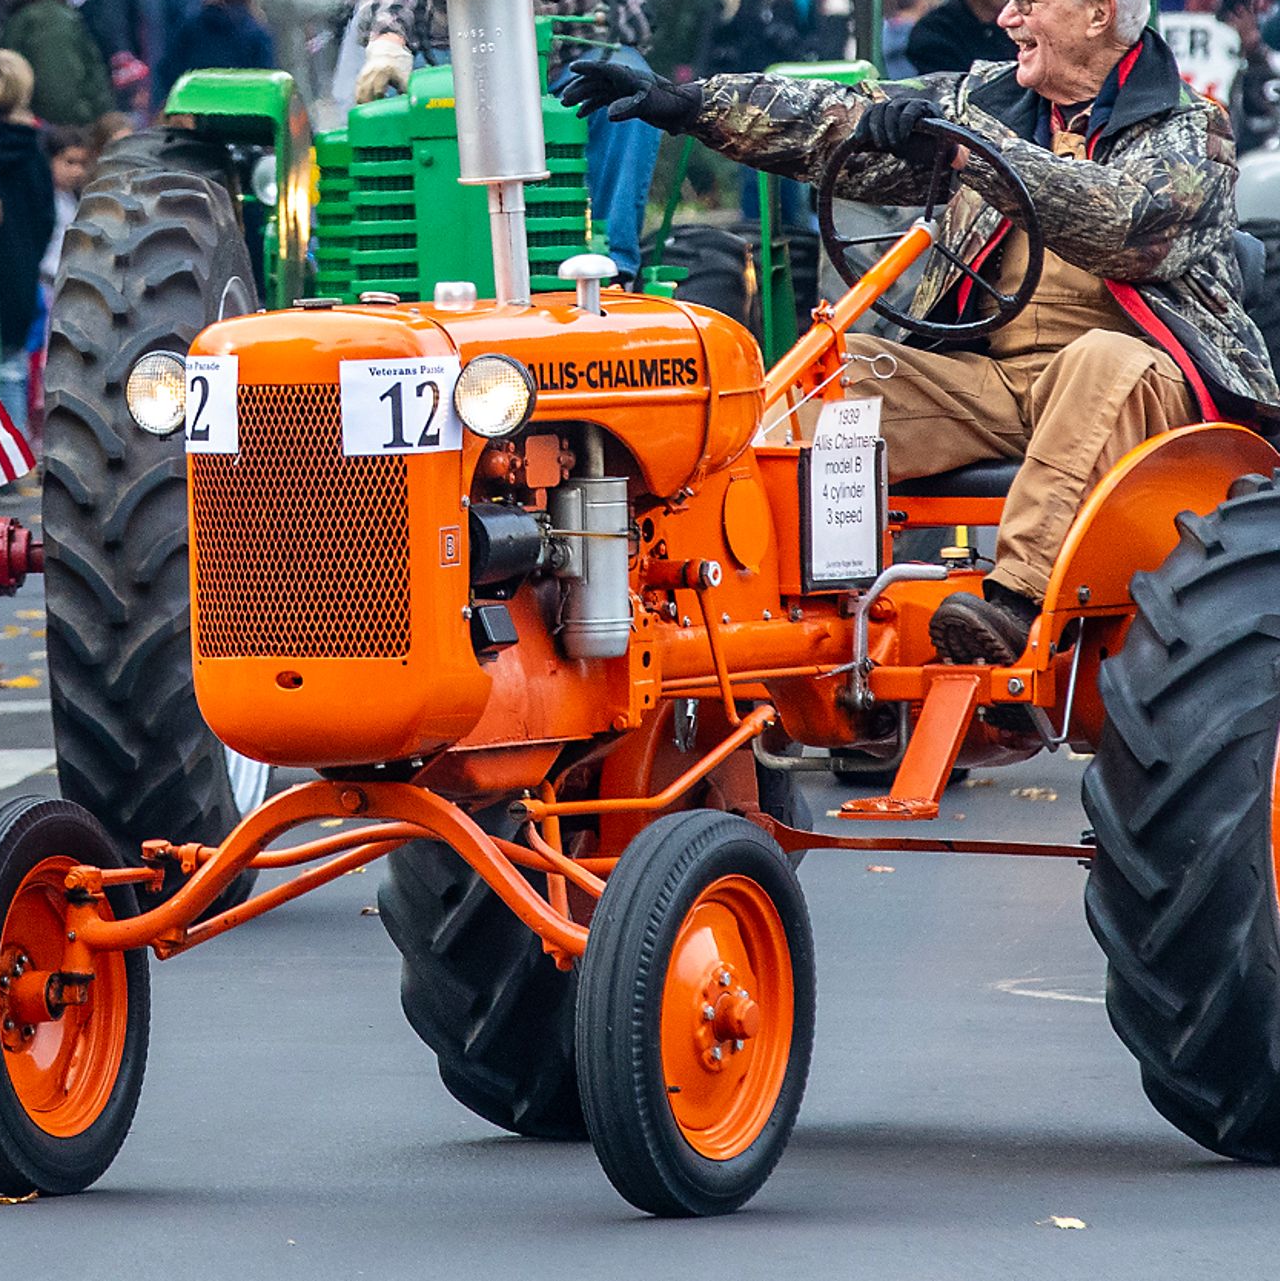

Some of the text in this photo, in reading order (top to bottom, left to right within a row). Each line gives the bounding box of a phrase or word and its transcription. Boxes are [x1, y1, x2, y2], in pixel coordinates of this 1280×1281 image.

[368, 366, 417, 377] Veterans
[186, 375, 210, 442] 2
[379, 379, 440, 449] 12
[839, 407, 861, 425] 1939
[814, 432, 877, 451] Allis Chalmers
[825, 456, 863, 475] model B
[822, 481, 866, 504] 4 cylinder
[826, 506, 863, 528] 3 speed
